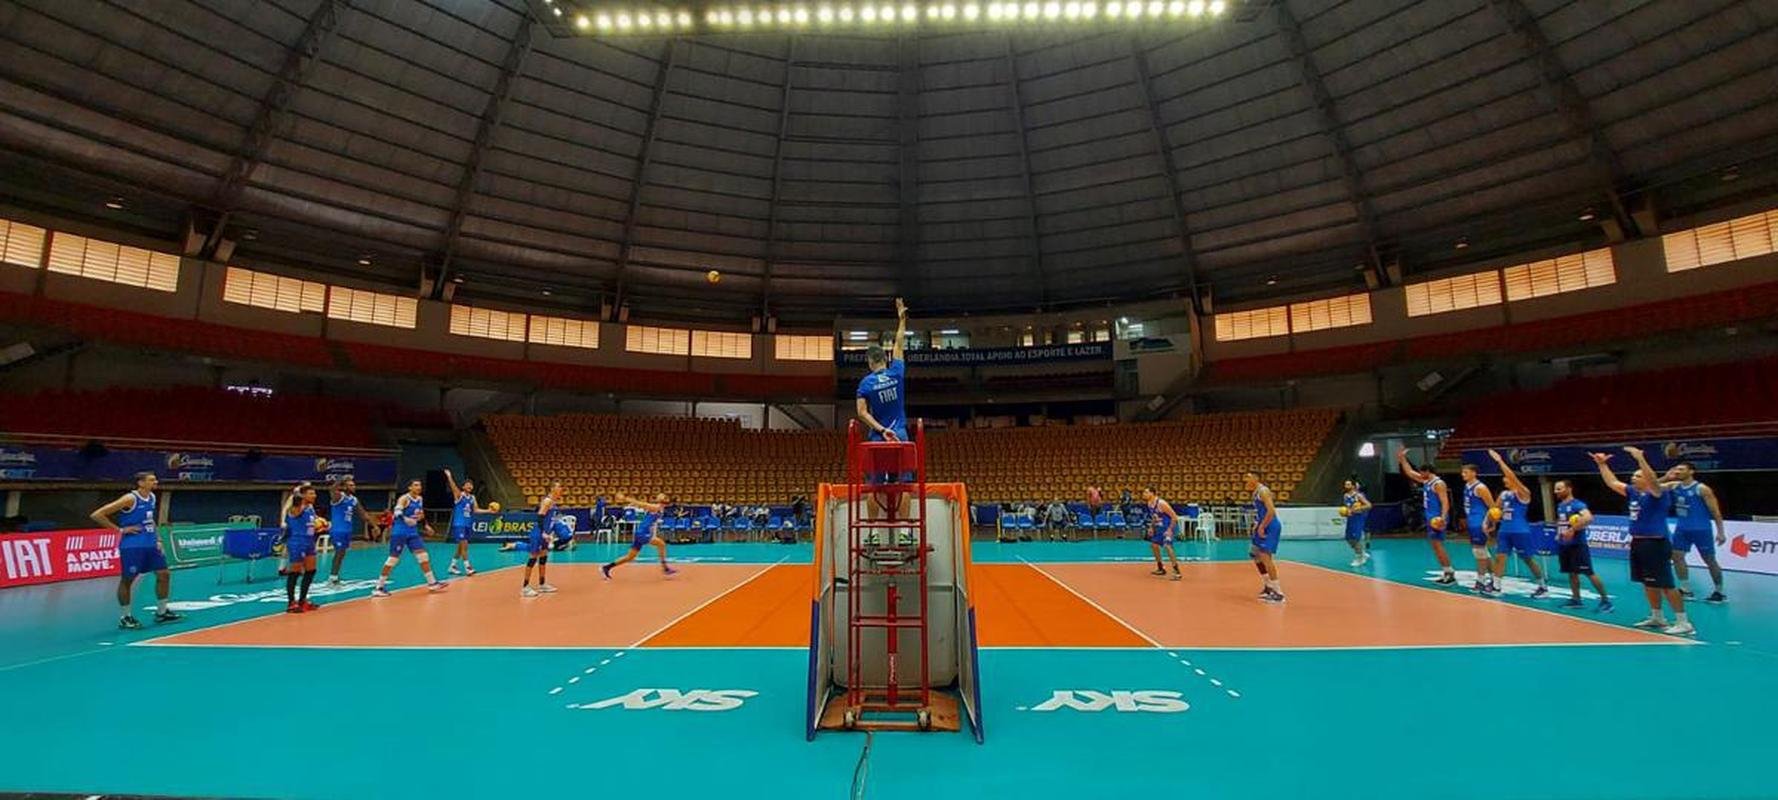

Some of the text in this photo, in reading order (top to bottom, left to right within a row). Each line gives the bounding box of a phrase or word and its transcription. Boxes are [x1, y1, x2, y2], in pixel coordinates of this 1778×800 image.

[878, 386, 898, 404] FIAT
[472, 522, 488, 532] LEI
[178, 536, 215, 547] Unimed
[0, 538, 52, 579] IAT
[66, 553, 78, 563] A
[579, 688, 760, 711] SKY
[1030, 689, 1191, 712] SKY
